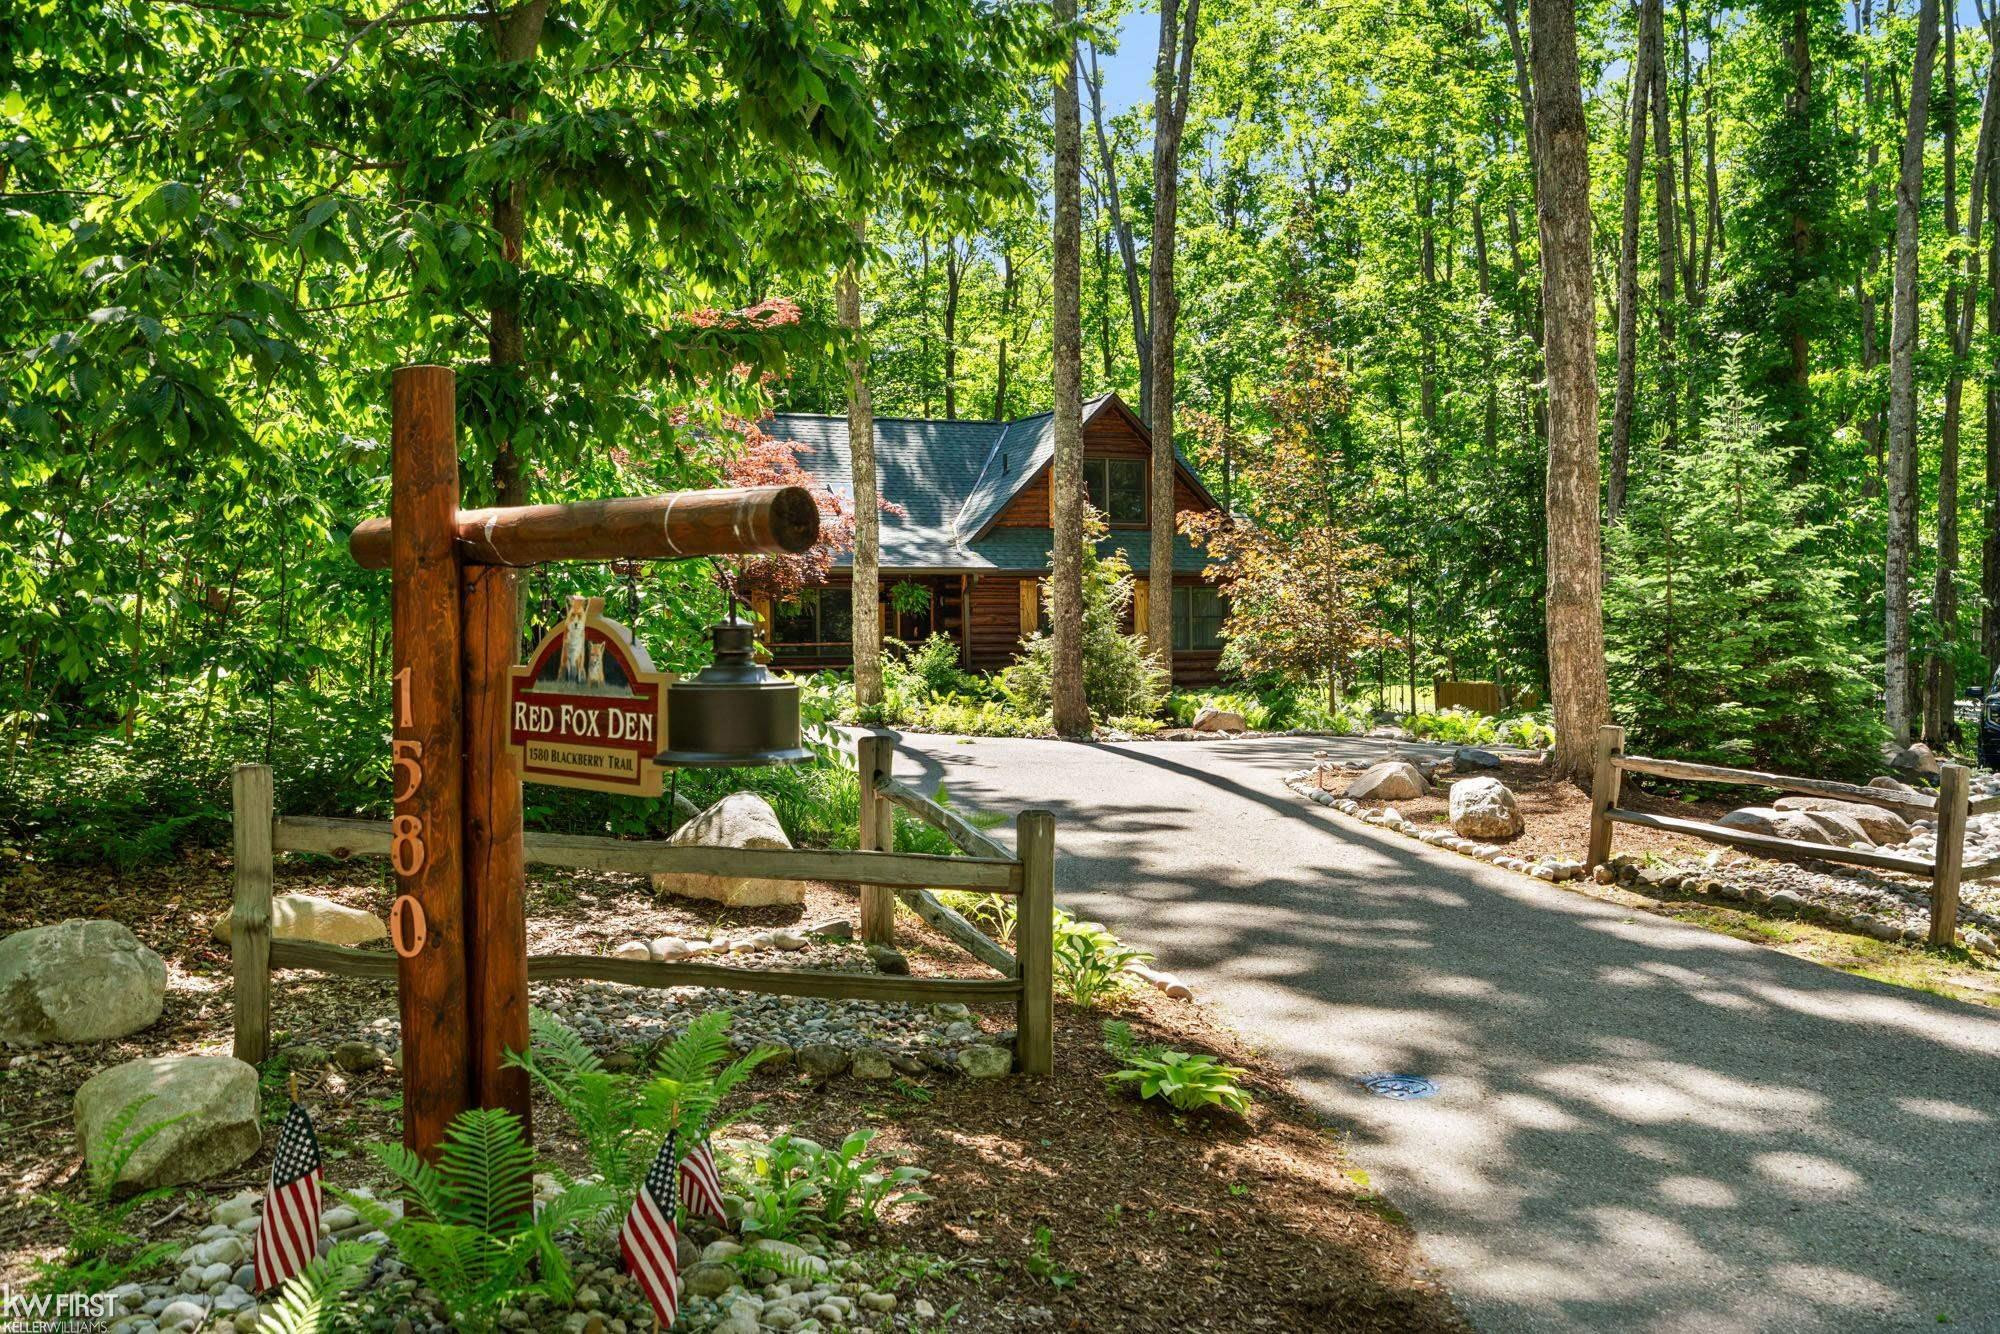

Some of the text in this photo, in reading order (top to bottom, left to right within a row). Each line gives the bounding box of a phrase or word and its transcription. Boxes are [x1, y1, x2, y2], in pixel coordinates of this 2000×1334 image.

[514, 701, 653, 742] RED FOX DEN
[529, 748, 634, 772] 1580 BLACKBERRY TRAIL
[391, 667, 426, 958] 1580
